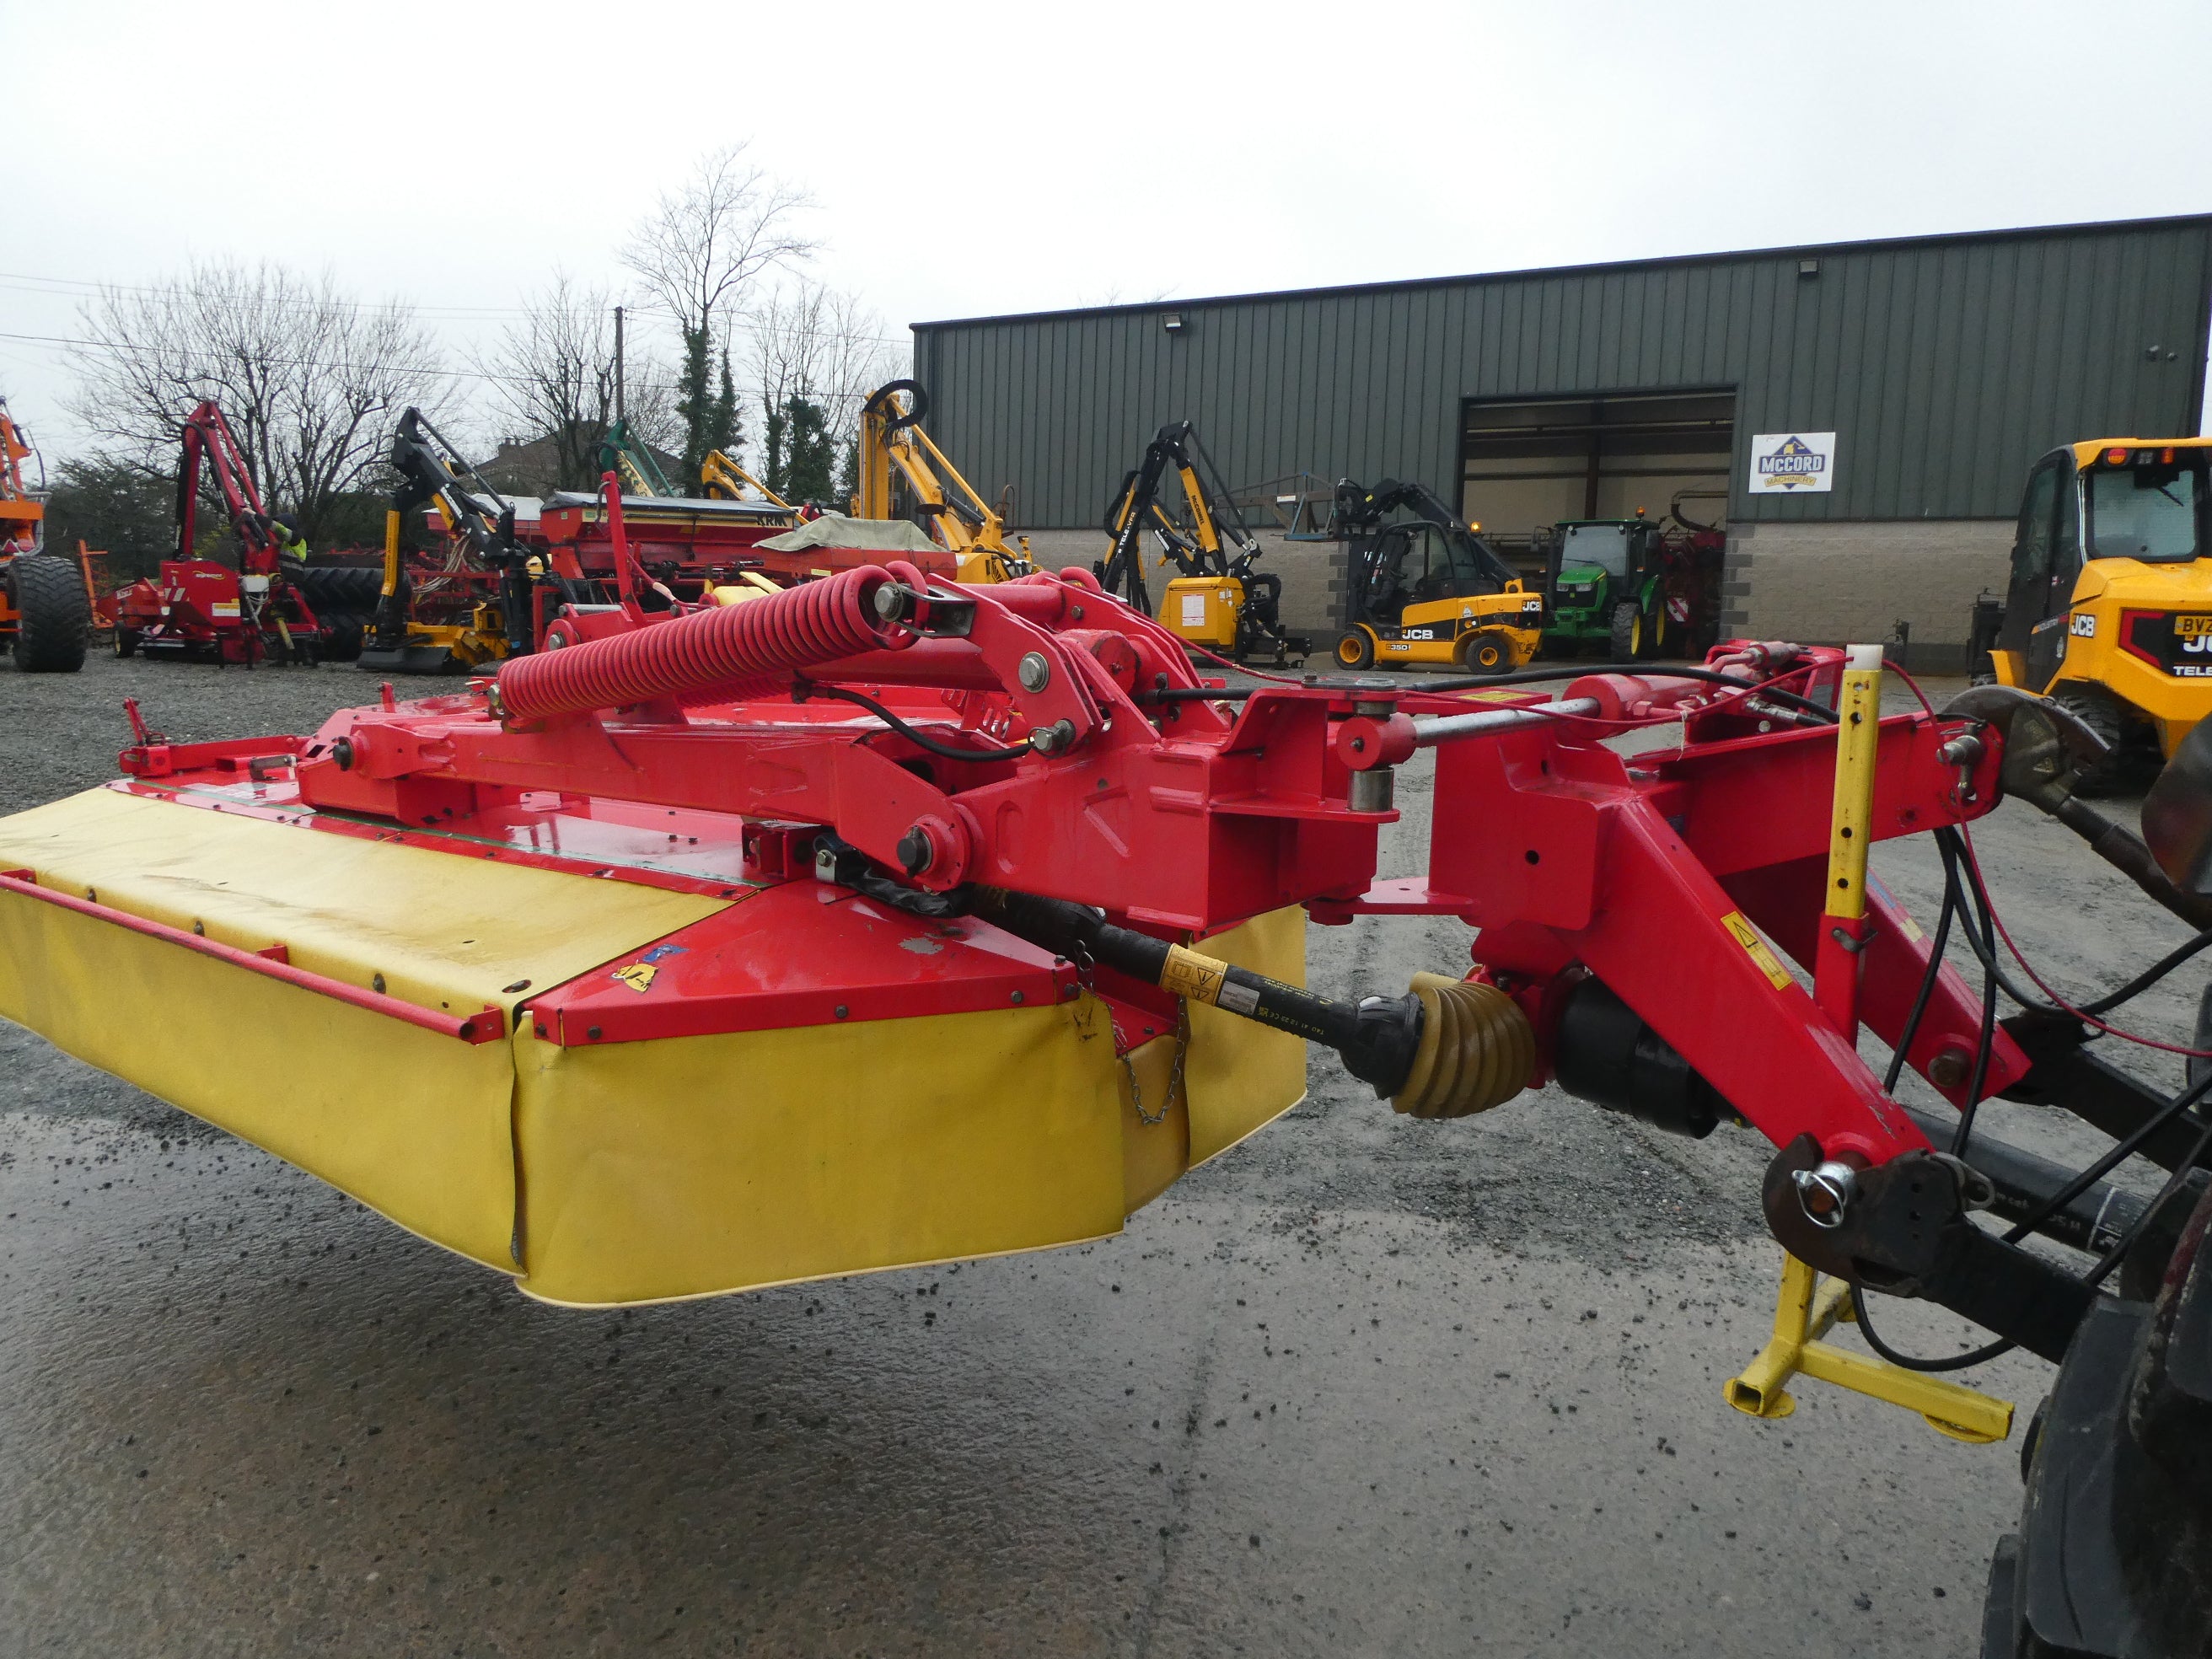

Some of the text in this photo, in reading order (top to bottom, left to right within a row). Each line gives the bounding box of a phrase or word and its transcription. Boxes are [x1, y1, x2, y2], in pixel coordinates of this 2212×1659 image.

[1766, 475, 1813, 485] MACHINERY
[2071, 615, 2095, 637] JCB
[1402, 629, 1433, 640] JCB
